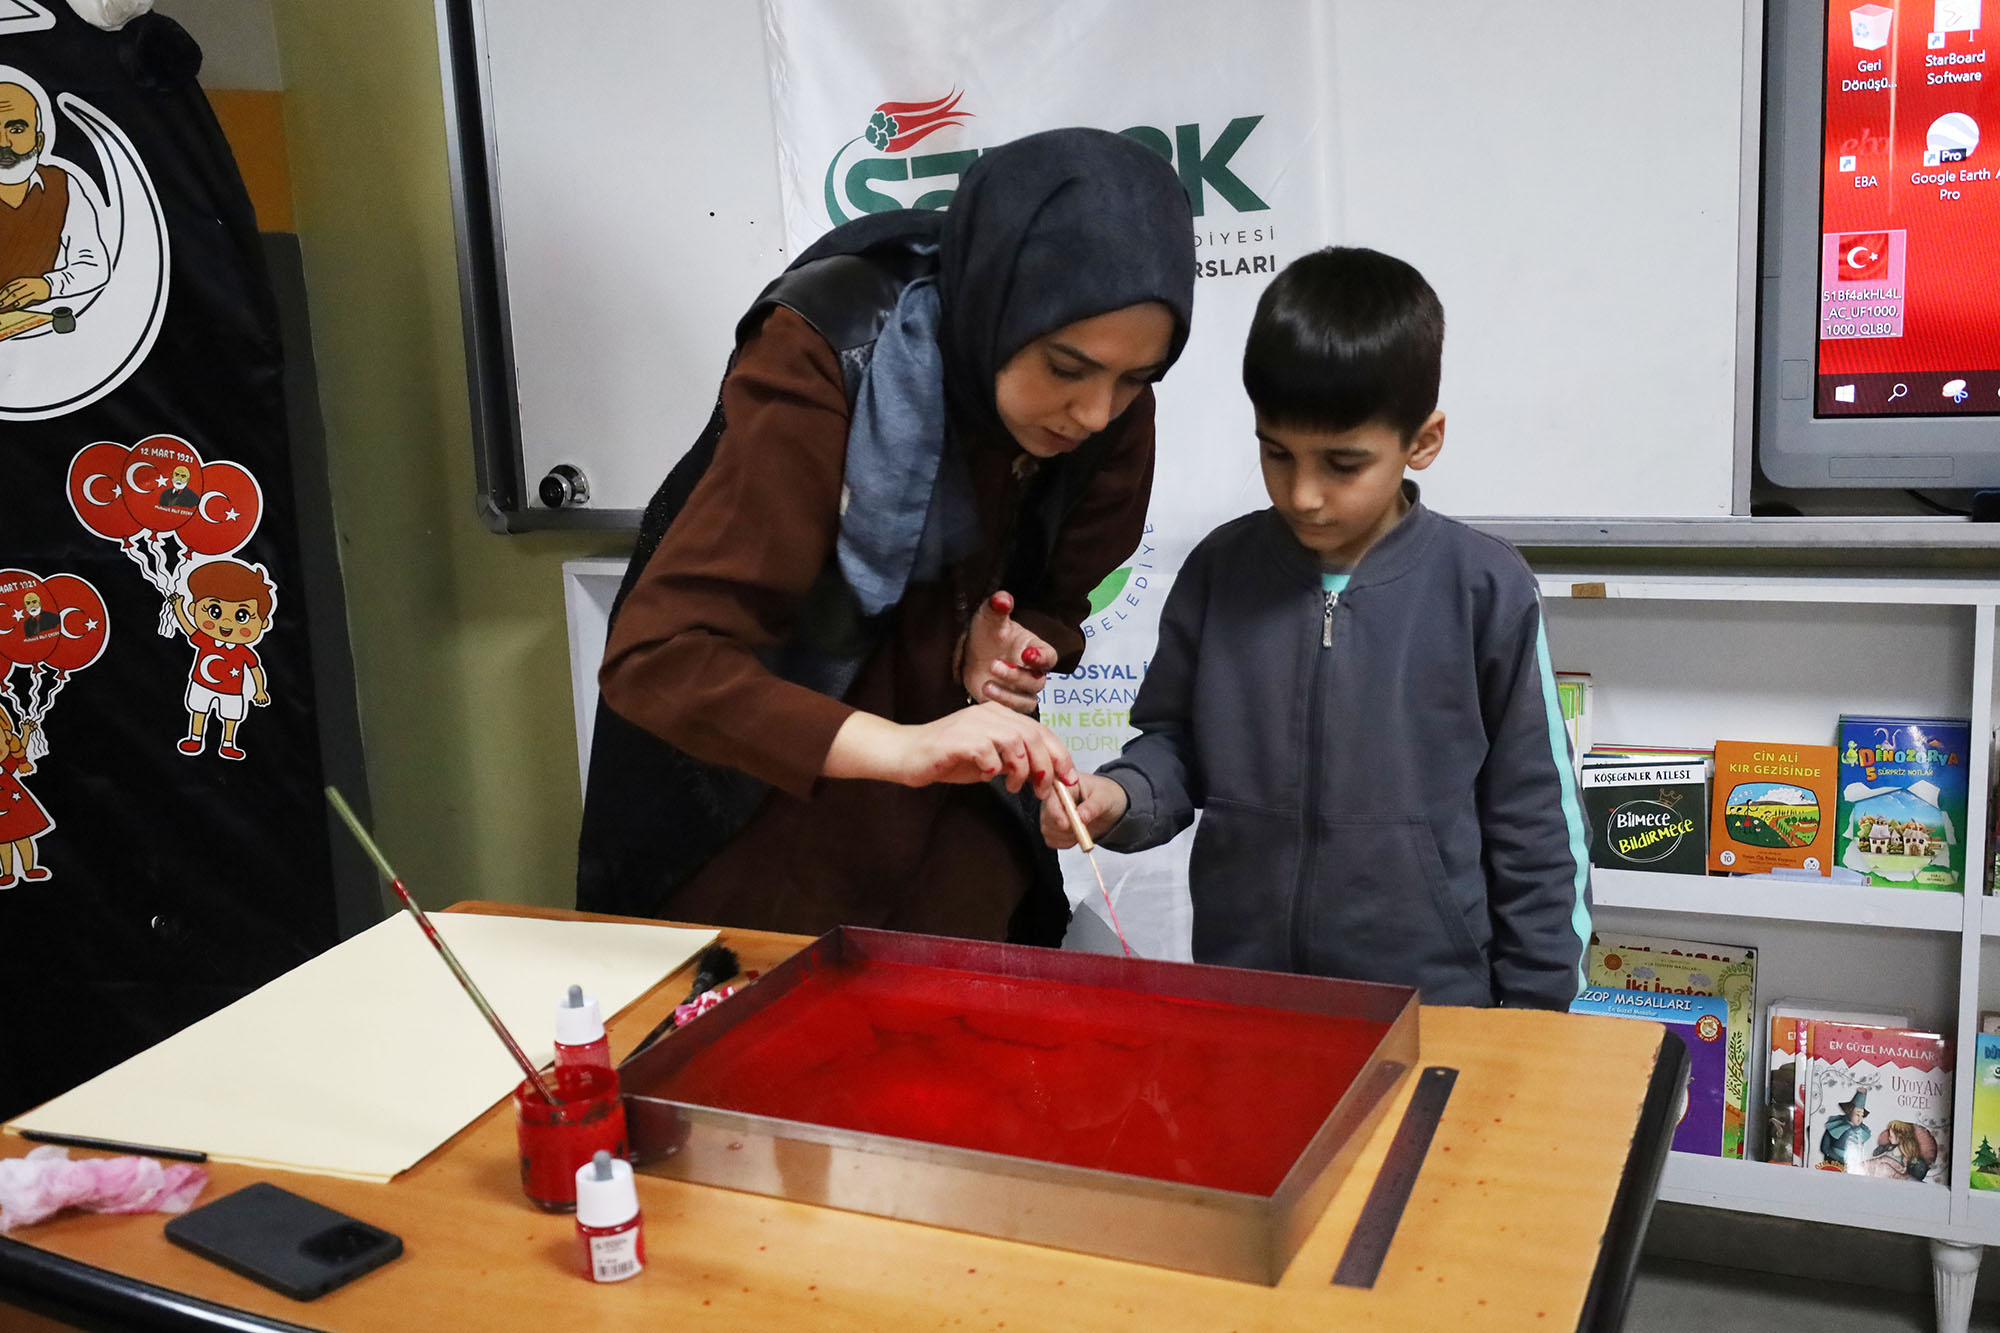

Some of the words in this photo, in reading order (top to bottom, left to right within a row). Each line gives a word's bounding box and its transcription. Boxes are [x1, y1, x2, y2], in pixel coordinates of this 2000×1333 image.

[1857, 59, 1882, 72] Geri
[1925, 50, 1986, 67] StarBoard
[1926, 70, 1983, 85] Software
[1942, 150, 1962, 161] Pro
[1854, 175, 1878, 188] EBA
[1911, 170, 1956, 186] Google
[1959, 168, 1991, 182] Earth
[1939, 189, 1961, 200] Pro
[140, 447, 149, 456] 12
[151, 448, 175, 459] MART
[177, 452, 194, 463] 1921
[20, 580, 37, 590] 1921
[1753, 750, 1775, 762] CİN
[1778, 752, 1799, 763] ALİ
[1729, 763, 1750, 774] KIR
[1753, 765, 1821, 778] GEZİSİNDE
[1865, 766, 1878, 781] 5
[1907, 768, 1934, 776] NOTLAR
[1723, 854, 1732, 863] 10
[1578, 989, 1609, 1002] ZOP
[1614, 993, 1692, 1011] MASALLARI
[1829, 1041, 1843, 1050] EN
[1846, 1041, 1876, 1054] GÜZEL
[1879, 1046, 1935, 1061] MASALLAR
[1892, 1076, 1944, 1097] UYUYAN
